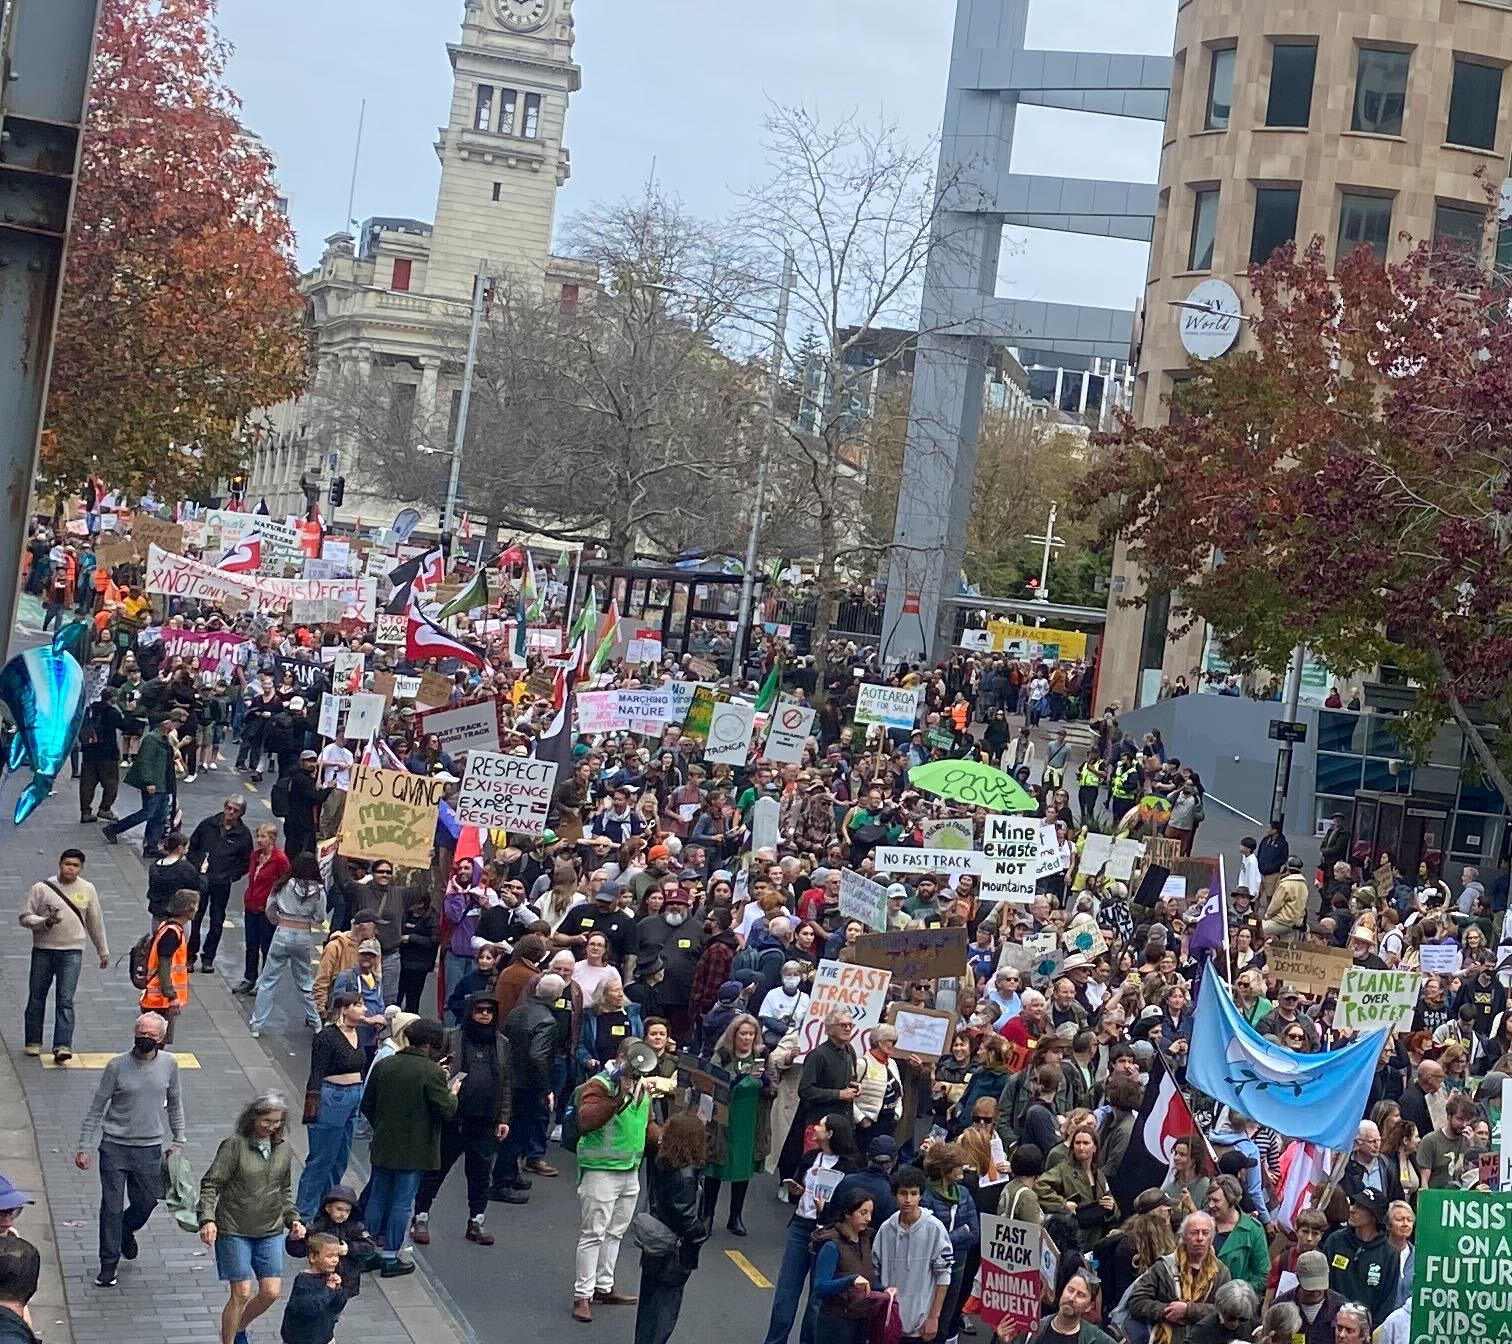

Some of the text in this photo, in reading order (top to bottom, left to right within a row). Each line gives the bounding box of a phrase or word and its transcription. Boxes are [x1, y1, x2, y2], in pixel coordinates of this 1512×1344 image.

[1185, 312, 1232, 332] World
[618, 694, 669, 704] MARCHING
[860, 687, 915, 703] AOTEAROA
[618, 706, 665, 716] NATURE
[455, 721, 482, 735] TRACK
[463, 726, 490, 740] TRACK
[706, 742, 746, 756] TAONGA
[471, 757, 554, 782] RESPECT
[463, 777, 548, 799] EXISTENCE
[494, 793, 512, 804] OR
[358, 802, 427, 827] MONEY
[459, 796, 528, 816] EXPECT
[459, 809, 543, 832] RESISTANCE
[991, 819, 1035, 840] Mine
[356, 826, 425, 851] HUNGRY
[883, 854, 971, 869] NO FAST TRACK
[995, 862, 1027, 875] NOT
[981, 876, 1034, 894] mountains
[820, 966, 891, 991] THE FAST
[1274, 959, 1326, 981] DEMOCRACY
[1346, 970, 1423, 994] PLANET
[817, 983, 869, 1006] TRACK
[1361, 993, 1390, 1005] OVER
[994, 1223, 1027, 1246] FAST
[989, 1241, 1033, 1267] TRACK
[1457, 1235, 1512, 1258] ON A
[985, 1271, 1036, 1299] ANIMAL
[982, 1289, 1039, 1319] CRUELTY
[1419, 1287, 1460, 1310] FOR
[1427, 1310, 1488, 1337] KIDS
